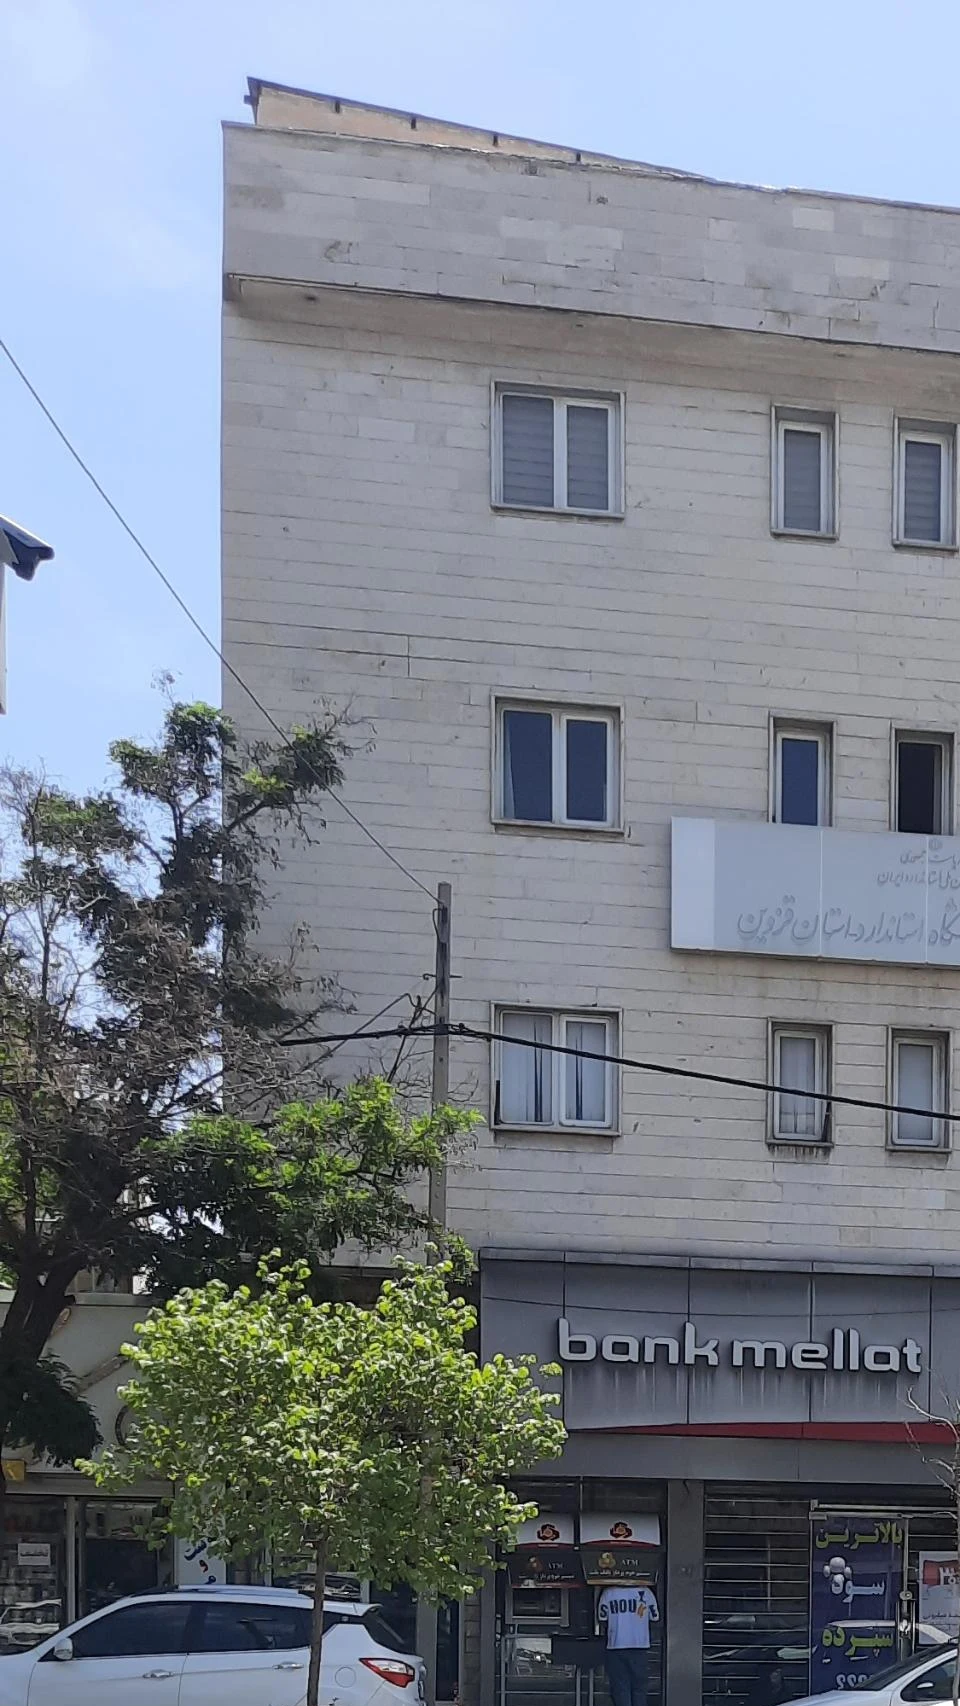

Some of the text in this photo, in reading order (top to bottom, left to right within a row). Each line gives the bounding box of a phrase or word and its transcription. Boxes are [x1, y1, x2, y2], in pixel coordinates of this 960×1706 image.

[558, 1317, 922, 1373] bank mellat
[815, 1520, 904, 1550] بالاترین
[831, 1575, 886, 1603] سود
[822, 1626, 895, 1658] سپرده
